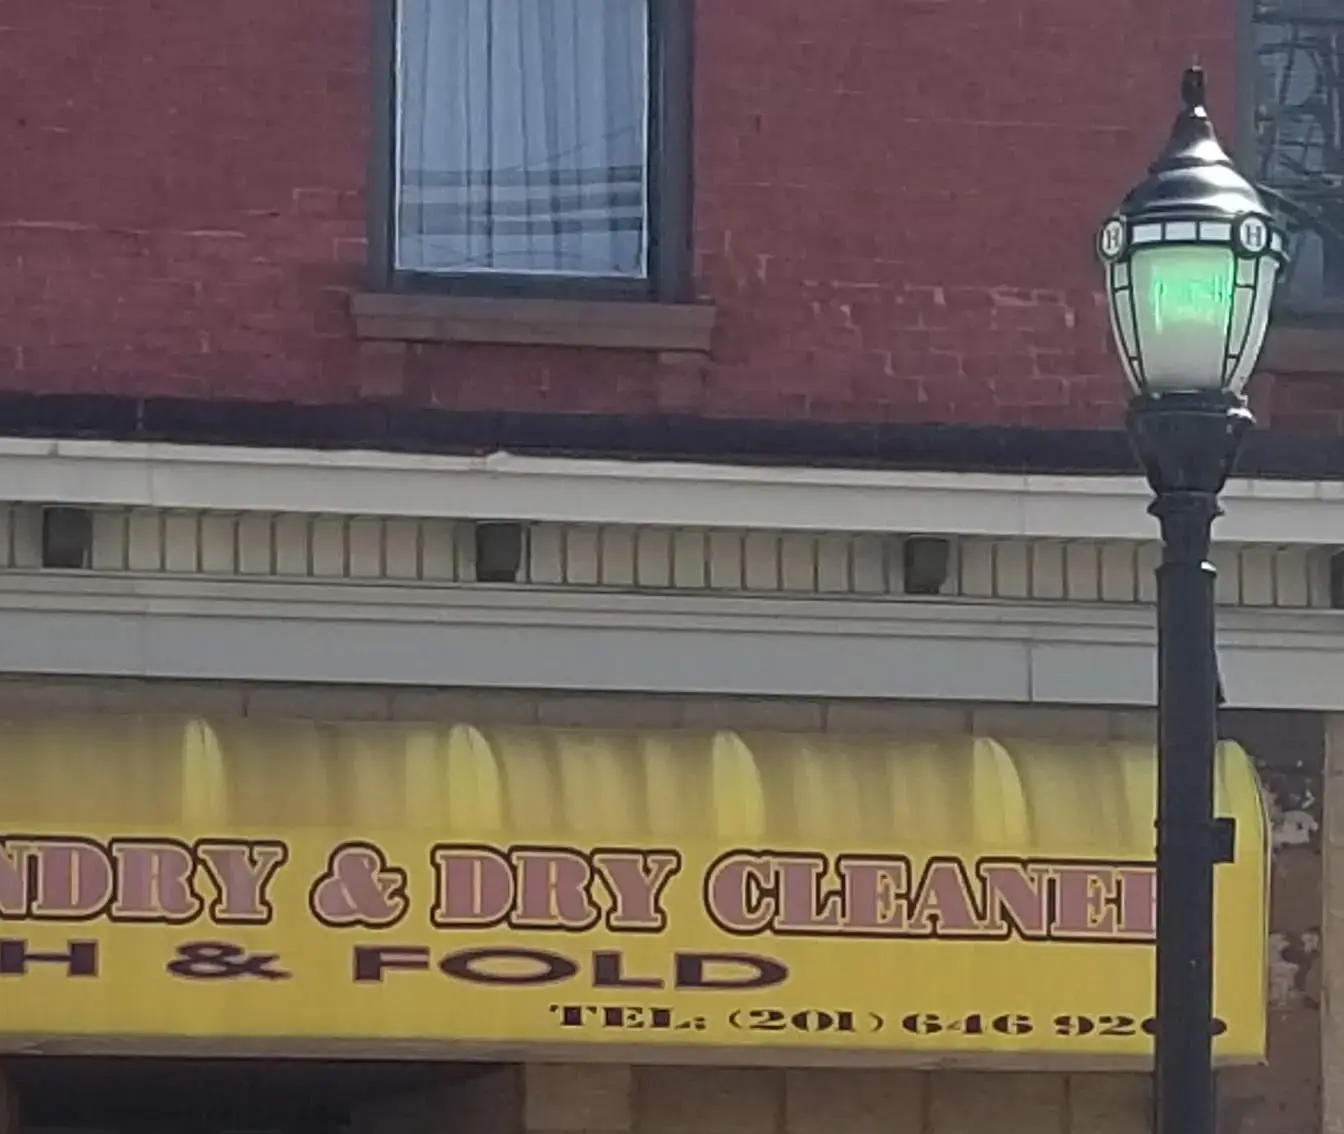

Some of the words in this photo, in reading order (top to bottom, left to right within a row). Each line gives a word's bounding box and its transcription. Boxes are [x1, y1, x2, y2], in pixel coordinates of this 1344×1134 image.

[308, 840, 409, 931] &
[430, 843, 681, 931] DRY
[166, 941, 291, 982] &
[352, 945, 790, 990] FOLD
[549, 1004, 708, 1031] TEL:
[728, 1008, 885, 1036] (201)
[902, 1011, 1034, 1037] 646
